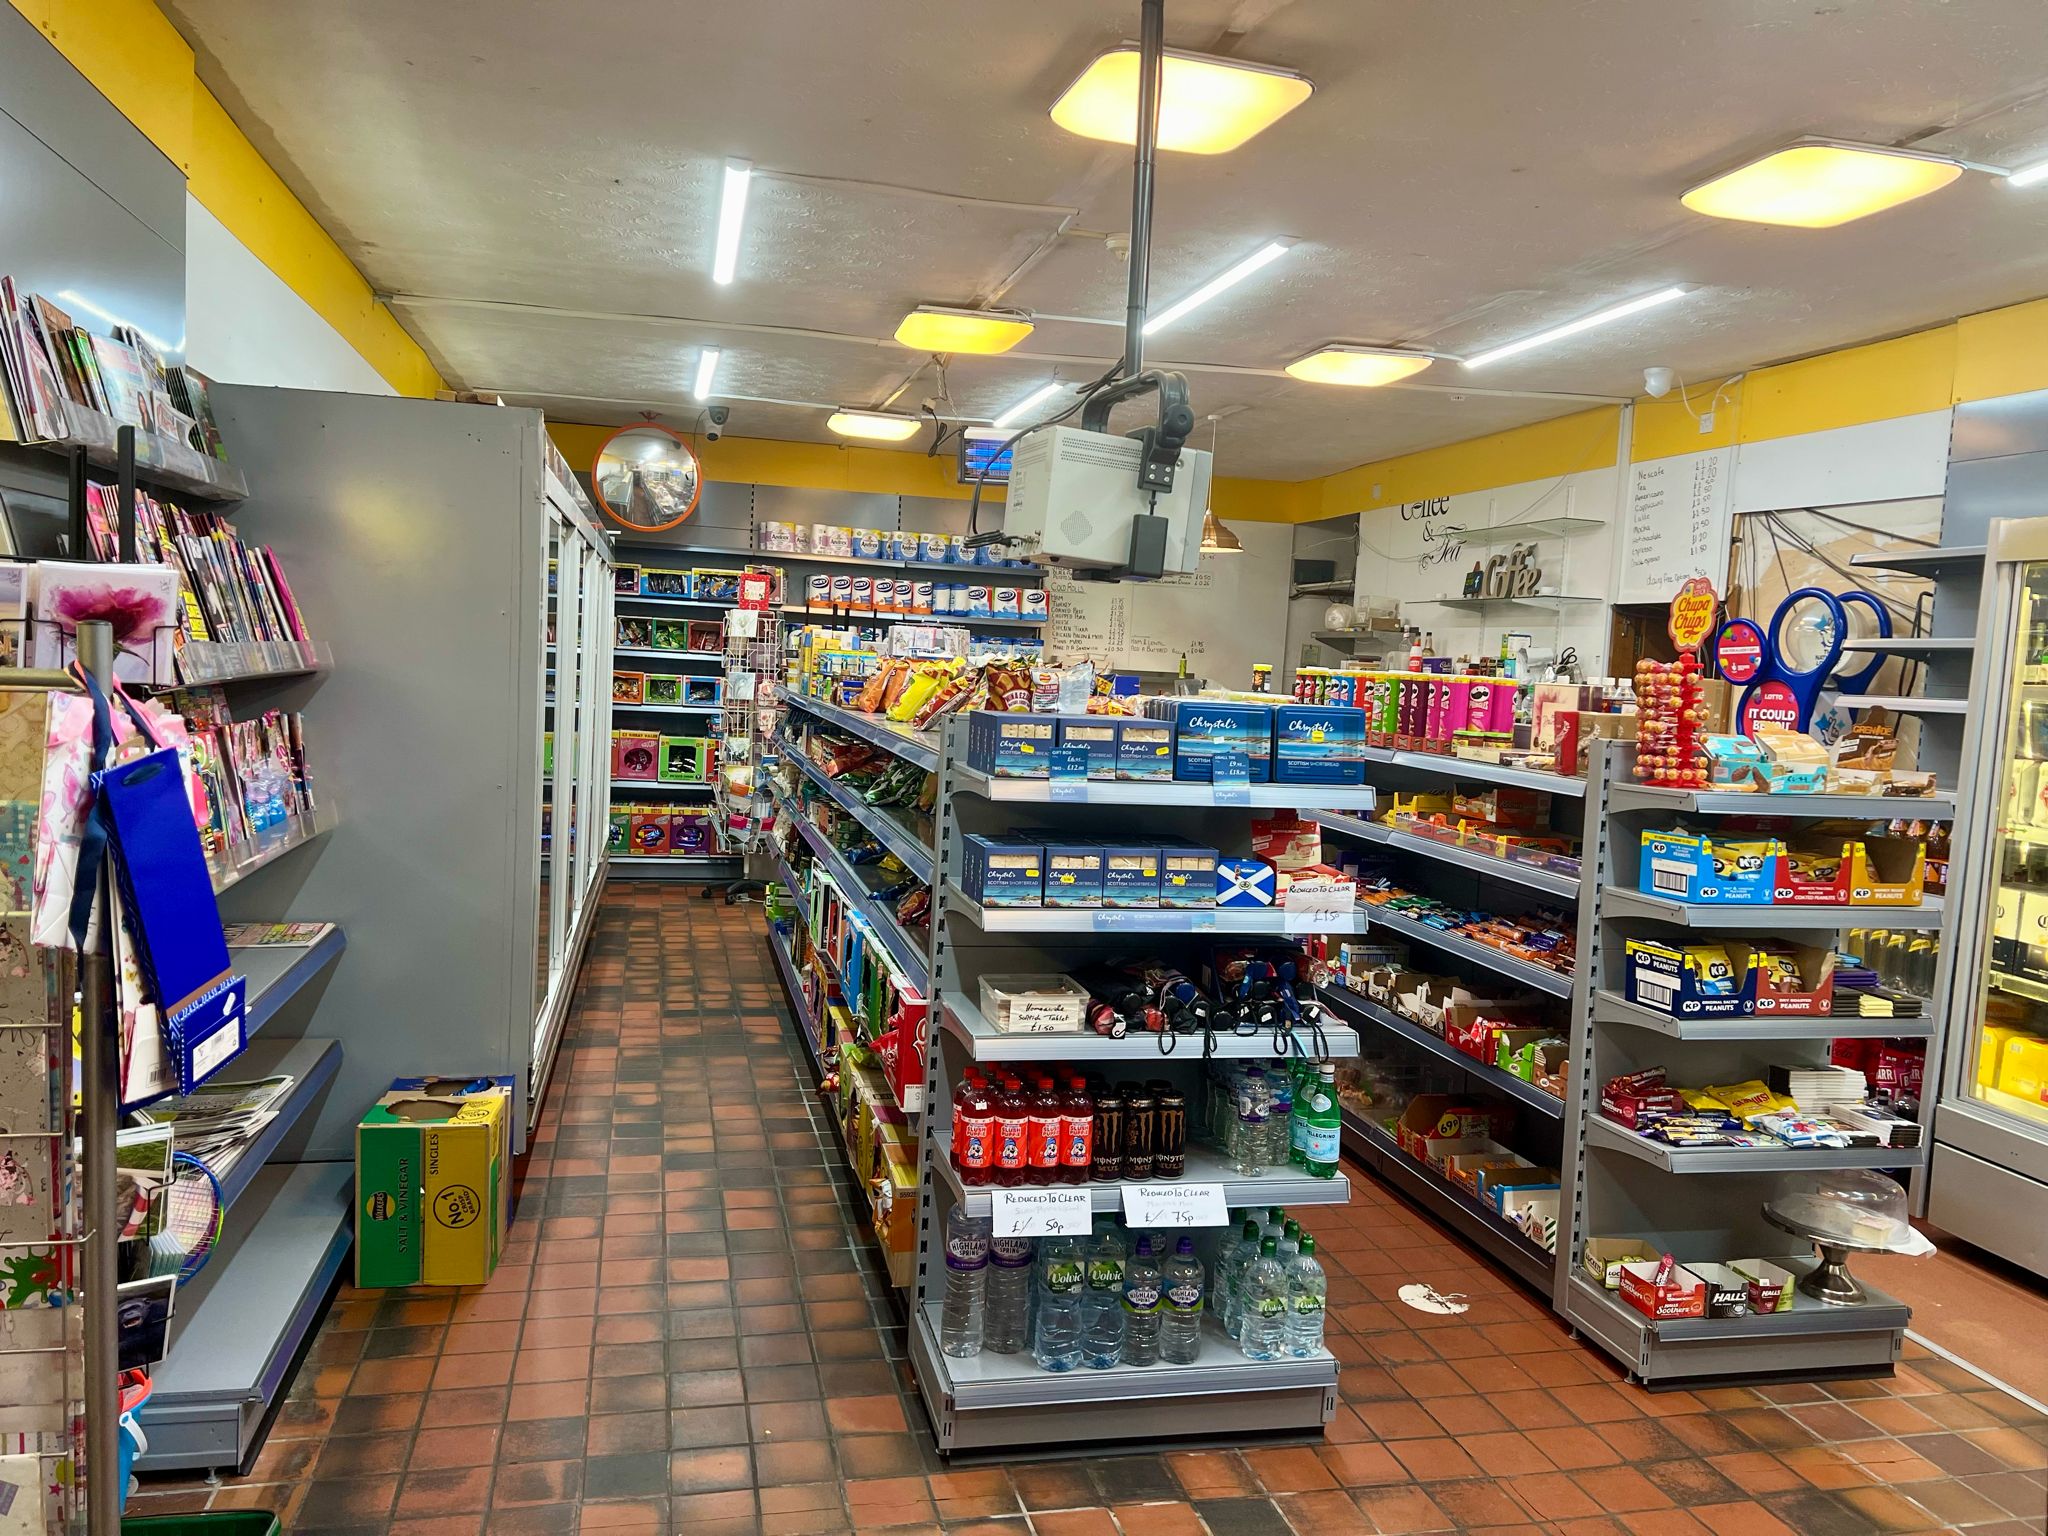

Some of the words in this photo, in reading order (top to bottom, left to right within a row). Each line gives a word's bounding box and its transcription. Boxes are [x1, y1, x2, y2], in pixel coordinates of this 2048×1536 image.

[1482, 541, 1542, 598] Coffee
[1677, 595, 1709, 612] Chupa
[1674, 611, 1707, 630] Chups
[1749, 709, 1759, 718] IT
[1760, 711, 1795, 720] COULD
[1189, 717, 1237, 733] Chrystal's
[1739, 858, 1761, 868] KP
[1638, 954, 1649, 962] KP
[1653, 961, 1678, 973] PEANUTS
[1711, 965, 1726, 975] KP
[1031, 1022, 1054, 1031] £1.50
[1440, 1119, 1458, 1134] 69p
[430, 1134, 439, 1175] SINGLES
[399, 1158, 409, 1209] VINEGAR
[1005, 1193, 1047, 1204] REDUCED
[1048, 1193, 1057, 1203] TO
[1058, 1194, 1086, 1203] CLEAR
[1184, 1188, 1210, 1197] CLEAR
[441, 1191, 464, 1225] NO.1
[401, 1213, 408, 1223] &
[1174, 1211, 1194, 1226] 75p
[1045, 1218, 1064, 1234] 50p
[399, 1228, 408, 1253] SALT
[951, 1240, 986, 1251] HIGHLAND
[993, 1239, 1028, 1248] HIGHLAND
[1052, 1272, 1083, 1284] Volvic
[1092, 1269, 1123, 1281] Volvic
[1128, 1290, 1158, 1299] HIGHLAND
[1169, 1289, 1199, 1297] HIGHLAND
[1713, 1292, 1747, 1303] HALLS
